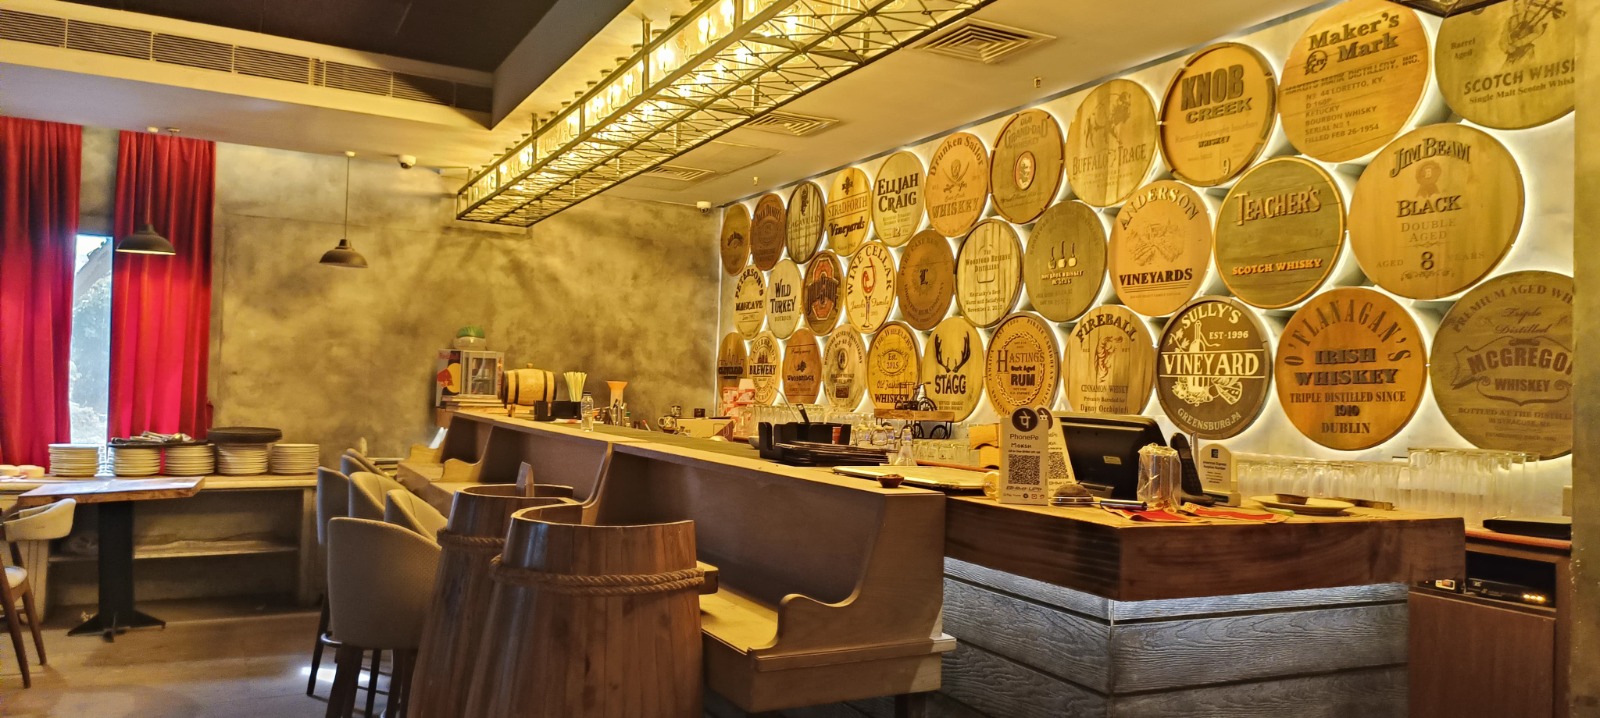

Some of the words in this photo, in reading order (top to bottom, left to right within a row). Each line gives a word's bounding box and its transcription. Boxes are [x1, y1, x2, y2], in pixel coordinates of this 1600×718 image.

[1308, 12, 1400, 51] Maker's
[1337, 32, 1399, 63] Mark
[1450, 37, 1476, 50] Barrel
[1454, 49, 1473, 59] Aged
[1181, 64, 1244, 111] KNOB
[1332, 81, 1369, 94] LORETTO,
[1464, 70, 1524, 95] SCOTCH
[1469, 94, 1494, 105] Single
[1495, 89, 1516, 99] Malt
[1517, 83, 1547, 95] Scotch
[1185, 97, 1253, 124] CREEK
[1305, 114, 1343, 127] BOURBON
[1345, 105, 1378, 118] WHISKY
[1304, 134, 1329, 144] FILLED
[1331, 130, 1346, 138] FEB
[1347, 123, 1379, 135] 26-1954
[1305, 125, 1330, 135] SERIAL
[929, 137, 963, 176] Drunken
[963, 136, 984, 166] Sailor
[1072, 152, 1109, 176] BUFFALO
[1117, 143, 1147, 166] TRACE
[1389, 143, 1422, 178] JIM
[1422, 137, 1472, 164] BEAM
[877, 172, 919, 197] ELIJAH
[828, 195, 868, 218] STRADFORTH
[878, 191, 917, 213] CRAIG
[932, 197, 979, 219] WHISKEY
[1121, 185, 1200, 231] ANDERSON
[1233, 185, 1322, 227] TEACHER'S
[1396, 195, 1463, 218] BLACK
[828, 216, 866, 238] Vineyards
[1400, 218, 1457, 233] DOUBLE
[1409, 230, 1448, 243] AGED
[847, 252, 864, 295] WINE
[865, 245, 892, 291] CELLAR
[1232, 263, 1273, 276] SCOTCH
[1275, 258, 1323, 271] WHISKY
[1376, 259, 1404, 269] AGED
[1420, 251, 1434, 270] 8
[1119, 267, 1193, 286] VINEYARDS
[774, 278, 791, 298] WILD
[770, 295, 797, 314] TURKEY
[1452, 288, 1506, 333] PREMIUM
[1511, 284, 1547, 295] AGED
[1500, 306, 1542, 324] Triple
[1181, 302, 1242, 330] SULLY'S
[1075, 313, 1137, 343] FIREBALL
[1284, 298, 1411, 366] O'FLANAGAN'S
[1495, 323, 1553, 335] Distilled
[996, 349, 1045, 374] HASTINGS
[1162, 352, 1260, 376] VINEYARD
[1314, 348, 1377, 365] IRISH
[749, 364, 777, 375] BREWERY
[1010, 374, 1036, 387] RUM
[1294, 368, 1399, 386] WHISKEY
[934, 374, 967, 395] STAGG
[1494, 377, 1551, 393] WHISKEY
[1289, 392, 1321, 403] TRIPLE
[1324, 391, 1373, 403] DISTILLED
[1375, 390, 1406, 402] SINCE
[1458, 407, 1498, 416] BOTTLED
[1499, 409, 1511, 417] AT
[1513, 410, 1532, 418] THE
[1009, 433, 1040, 441] PhonePe
[1321, 422, 1371, 434] DUBLIN
